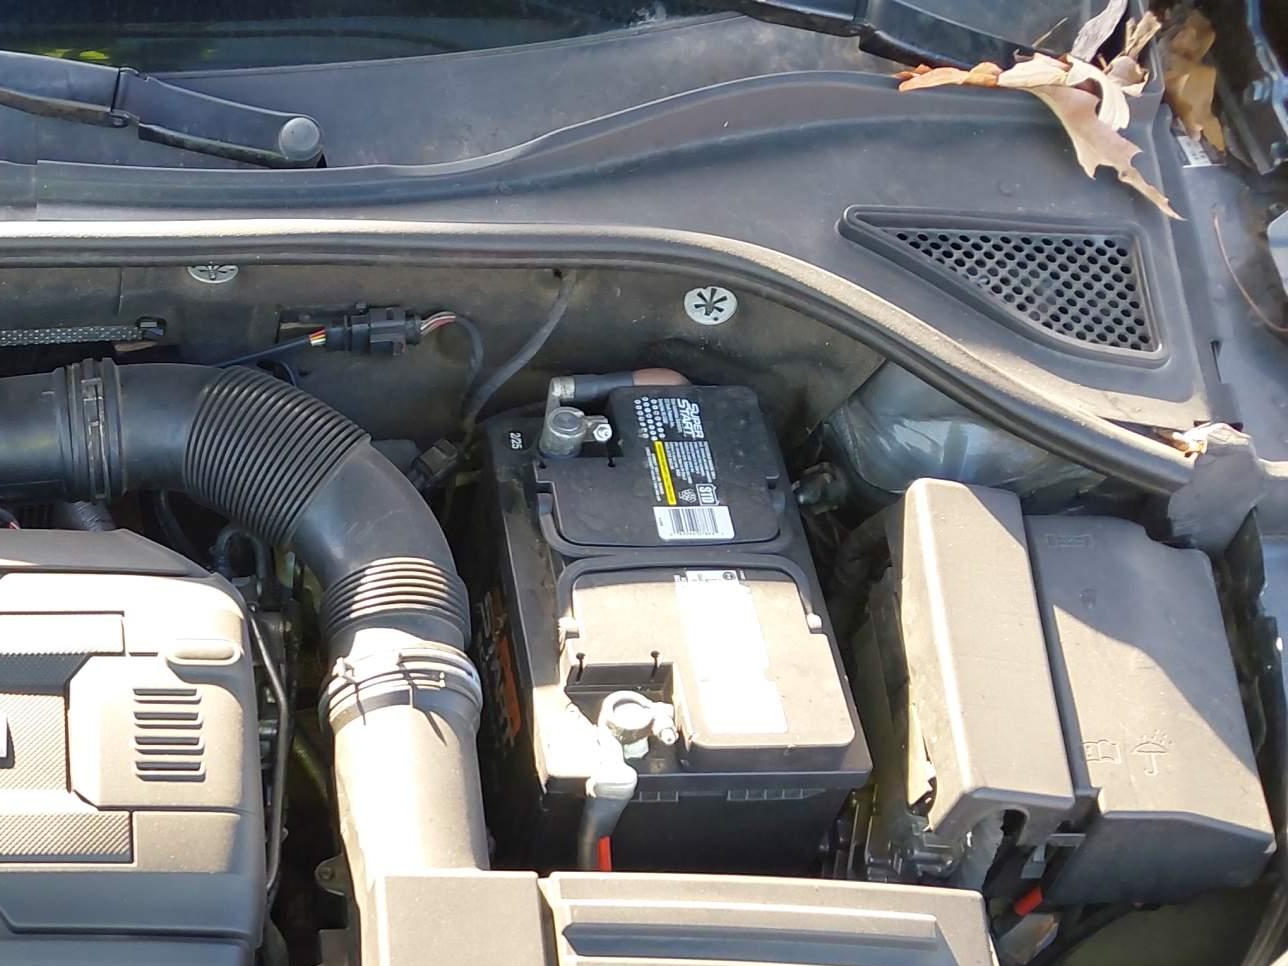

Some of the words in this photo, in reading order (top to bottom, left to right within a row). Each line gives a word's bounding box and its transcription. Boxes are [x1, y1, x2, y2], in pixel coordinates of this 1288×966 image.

[677, 398, 696, 439] START
[690, 402, 704, 439] SUPER
[510, 432, 522, 450] 2/25
